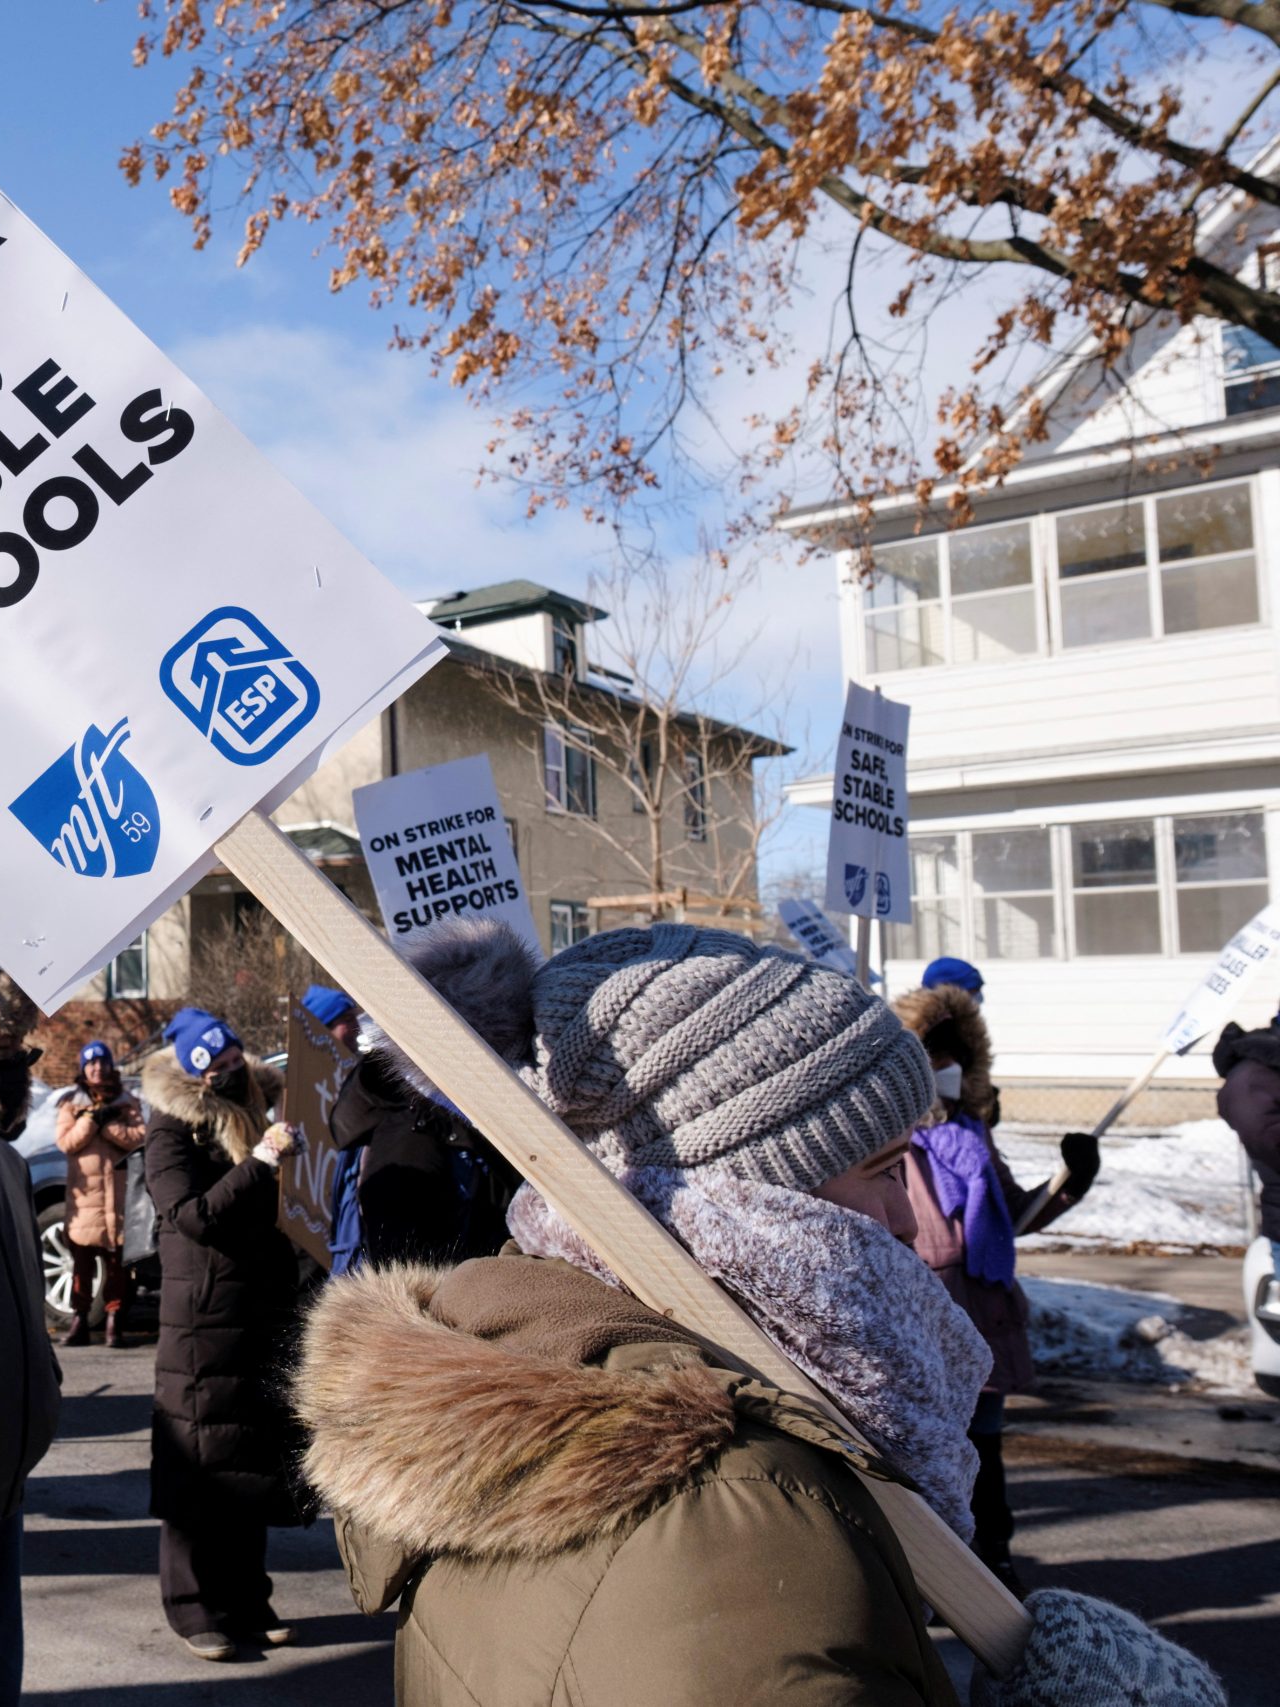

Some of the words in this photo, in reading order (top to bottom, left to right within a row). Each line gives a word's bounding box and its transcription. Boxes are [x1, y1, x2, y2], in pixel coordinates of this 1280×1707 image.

[224, 674, 277, 730] ESP
[851, 749, 888, 784] SAFE,
[884, 738, 904, 757] FOR
[843, 774, 894, 810] STABLE
[120, 811, 152, 843] 59
[370, 832, 400, 853] ON
[404, 814, 465, 843] STRIKE
[465, 806, 496, 826] FOR
[834, 799, 904, 838] SCHOOLS
[394, 833, 491, 877] MENTAL
[406, 858, 498, 902] HEALTH
[393, 879, 519, 934] SUPPORTS
